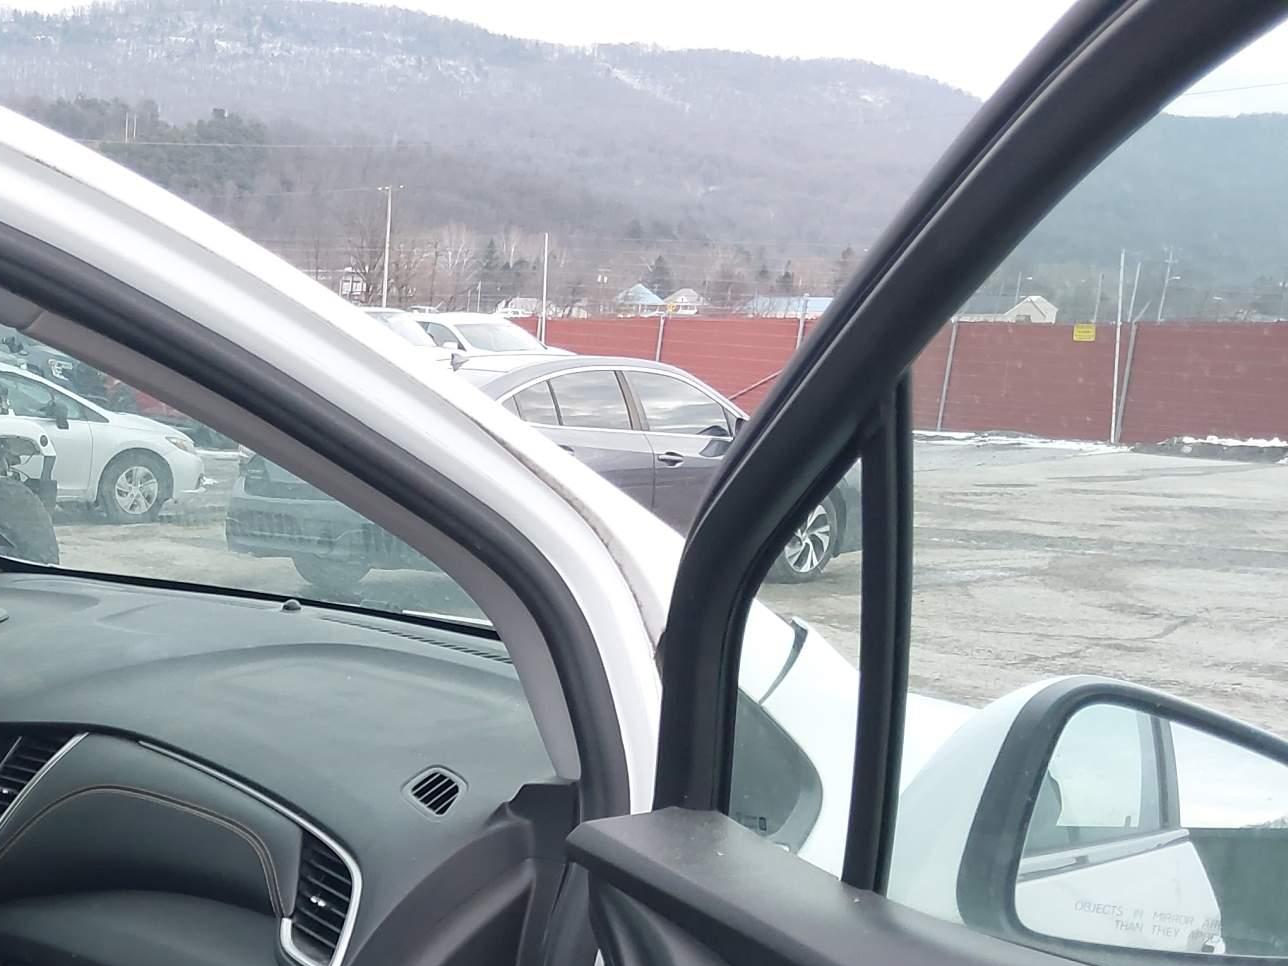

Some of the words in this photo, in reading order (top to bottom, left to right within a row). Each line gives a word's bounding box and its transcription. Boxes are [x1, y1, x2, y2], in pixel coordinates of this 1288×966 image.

[1074, 900, 1124, 916] OBJECTS
[1152, 911, 1195, 926] MIRROR
[1114, 919, 1144, 933] THAN
[1152, 924, 1180, 938] THEY
